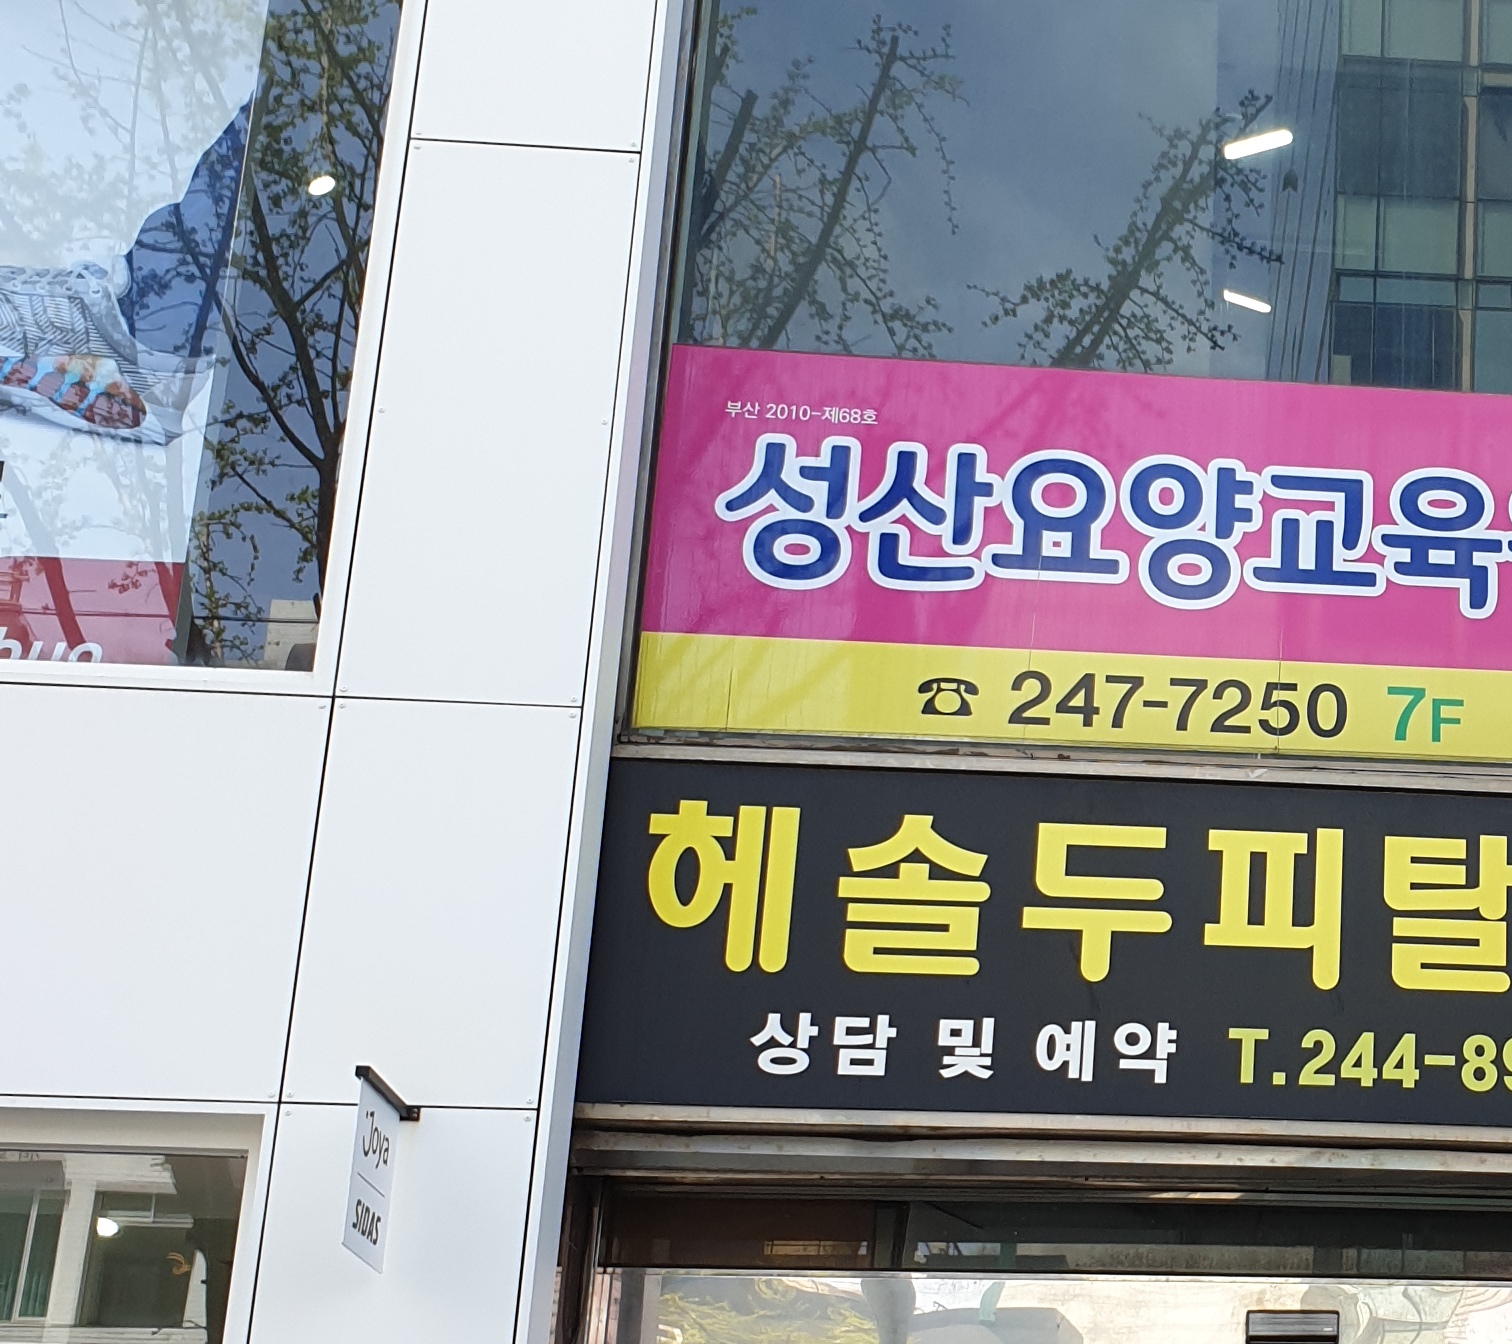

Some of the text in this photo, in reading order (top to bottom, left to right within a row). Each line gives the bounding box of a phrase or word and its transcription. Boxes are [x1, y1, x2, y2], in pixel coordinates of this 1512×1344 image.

[725, 400, 878, 425] 부산 2010-제68호
[1007, 669, 1466, 743] 247-7250 7F
[748, 1011, 898, 1079] 상담
[938, 1017, 996, 1081] 및
[1035, 1018, 1178, 1084] 예약
[352, 1199, 381, 1246] SIDAS
